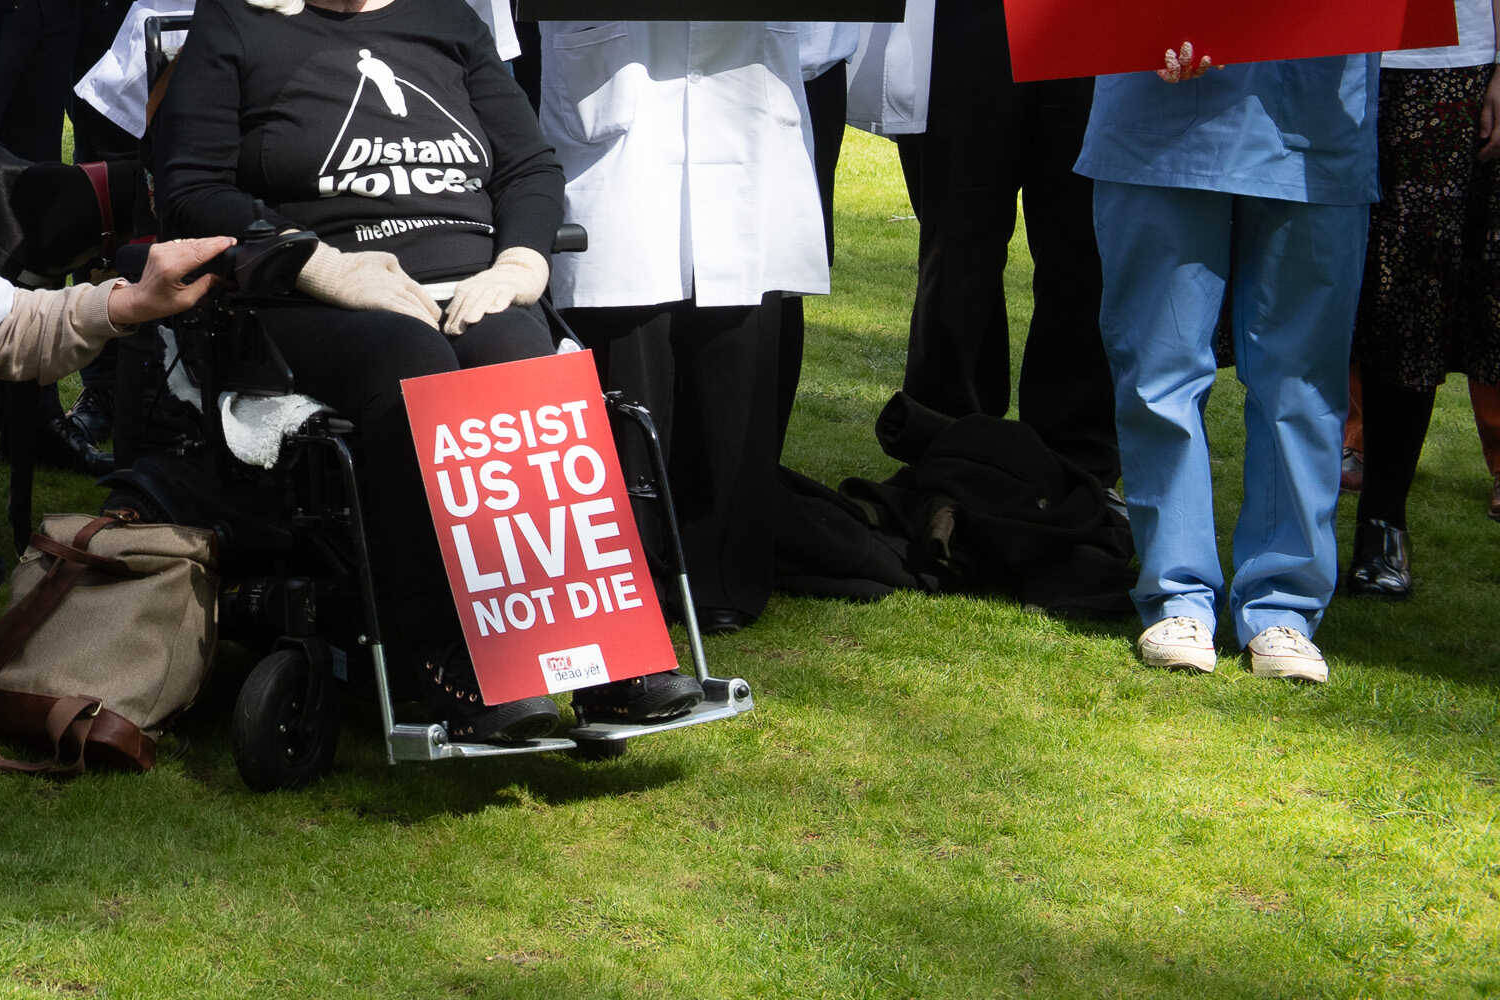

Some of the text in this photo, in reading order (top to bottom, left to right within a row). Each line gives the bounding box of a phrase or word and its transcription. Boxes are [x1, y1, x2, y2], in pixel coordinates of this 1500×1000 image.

[344, 131, 479, 170] Distant
[434, 400, 589, 464] ASSIST
[436, 444, 607, 519] US TO
[451, 497, 632, 593] LIVE
[471, 572, 644, 638] NOT DIE
